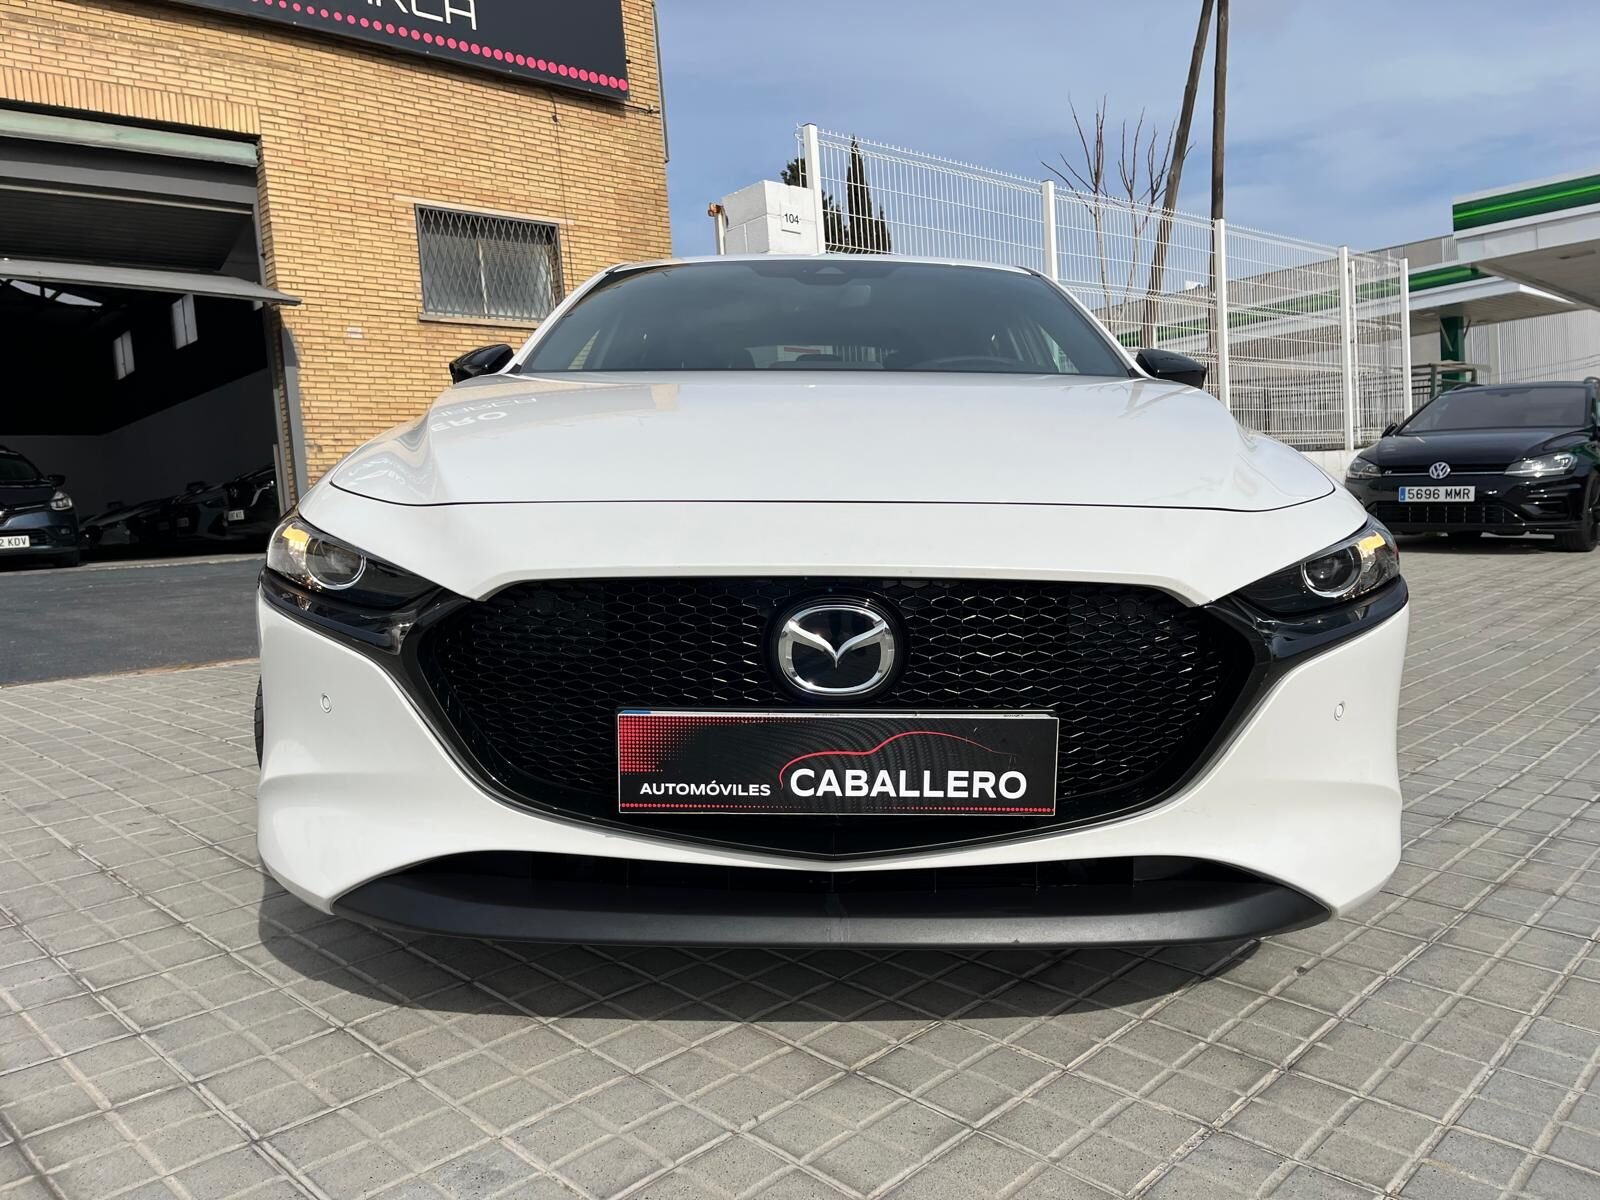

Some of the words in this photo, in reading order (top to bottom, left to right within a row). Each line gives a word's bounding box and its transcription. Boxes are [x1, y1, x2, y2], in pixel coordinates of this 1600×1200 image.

[784, 213, 799, 225] 104
[1407, 488, 1440, 500] 5696
[1445, 487, 1471, 500] MMR
[8, 537, 26, 547] KDV
[639, 779, 772, 796] AUTOMÓVILES
[790, 768, 1028, 800] CABALLERO
